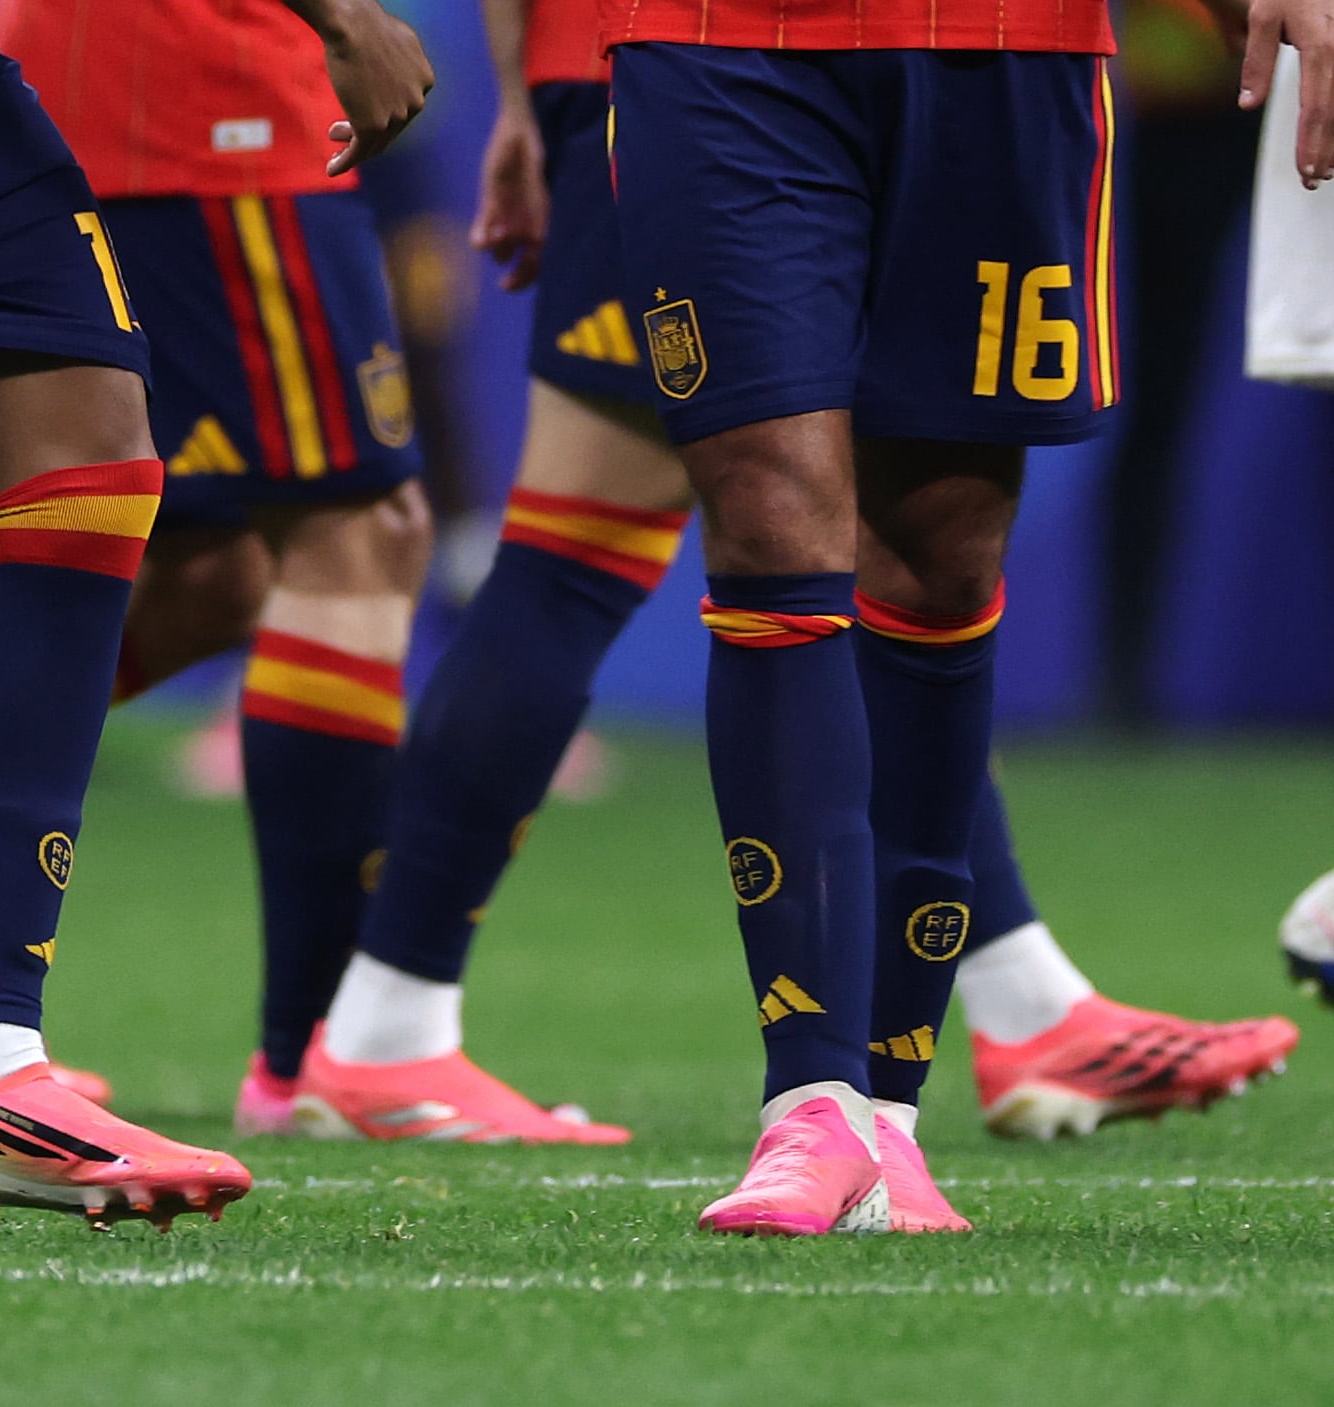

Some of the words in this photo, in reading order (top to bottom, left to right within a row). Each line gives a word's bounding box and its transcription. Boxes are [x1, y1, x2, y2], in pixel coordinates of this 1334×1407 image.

[72, 211, 142, 333] 1
[972, 260, 1080, 401] 16
[735, 870, 764, 892] EF
[926, 915, 961, 929] RF
[922, 933, 958, 948] EF
